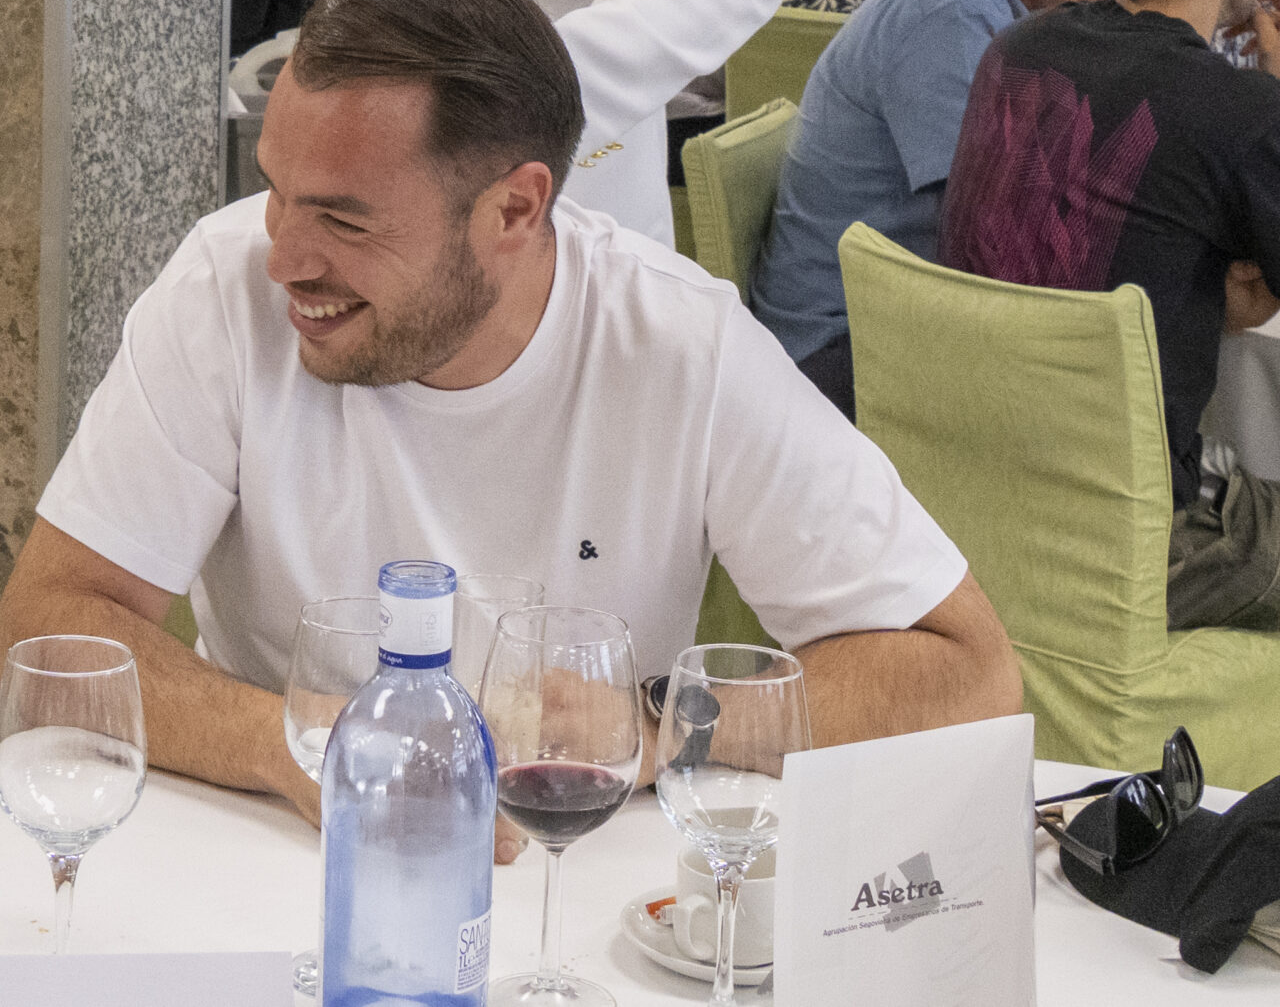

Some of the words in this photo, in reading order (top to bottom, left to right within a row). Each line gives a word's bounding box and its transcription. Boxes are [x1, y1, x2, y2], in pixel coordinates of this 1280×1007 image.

[579, 539, 599, 561] &
[850, 880, 944, 911] Asetra
[460, 915, 490, 955] SANT
[823, 923, 858, 937] Agrupación
